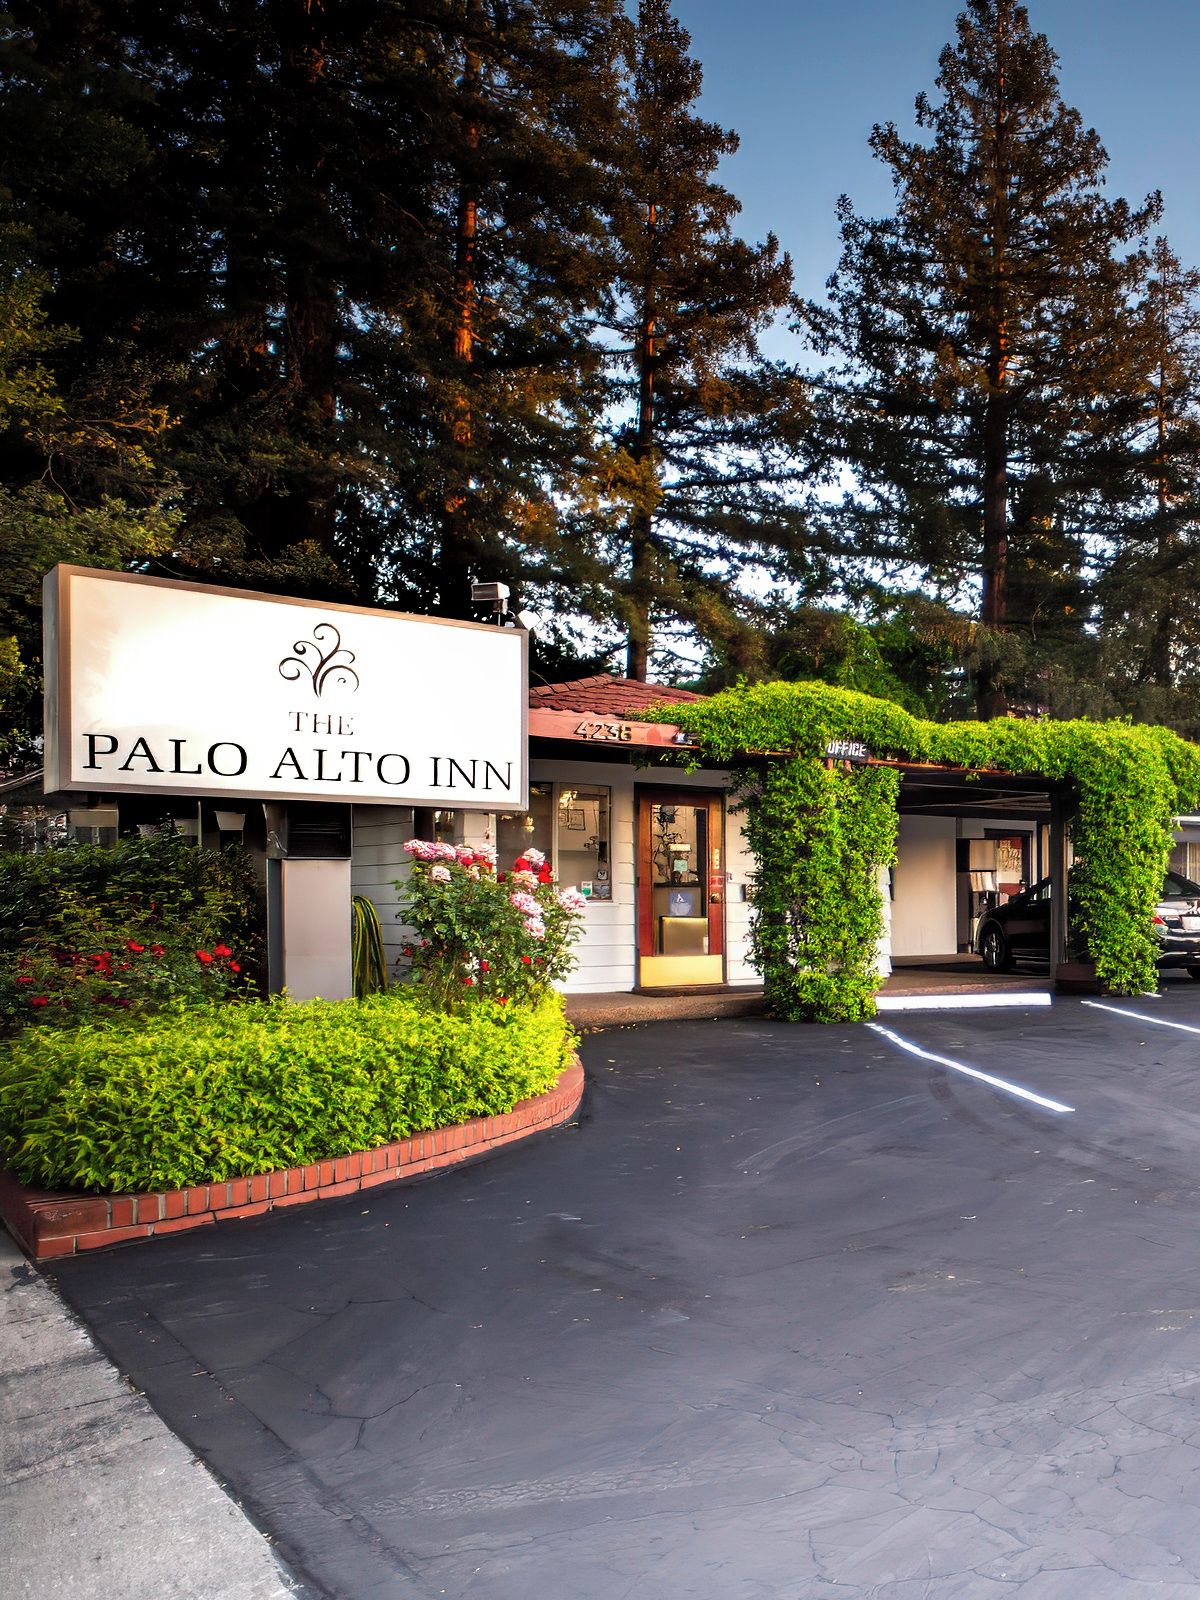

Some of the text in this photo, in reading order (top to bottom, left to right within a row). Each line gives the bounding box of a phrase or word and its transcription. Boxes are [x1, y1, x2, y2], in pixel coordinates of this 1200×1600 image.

[289, 712, 353, 735] THE
[574, 720, 632, 741] 4236
[827, 740, 867, 757] OFFICE
[82, 733, 513, 791] PALO ALTO INN
